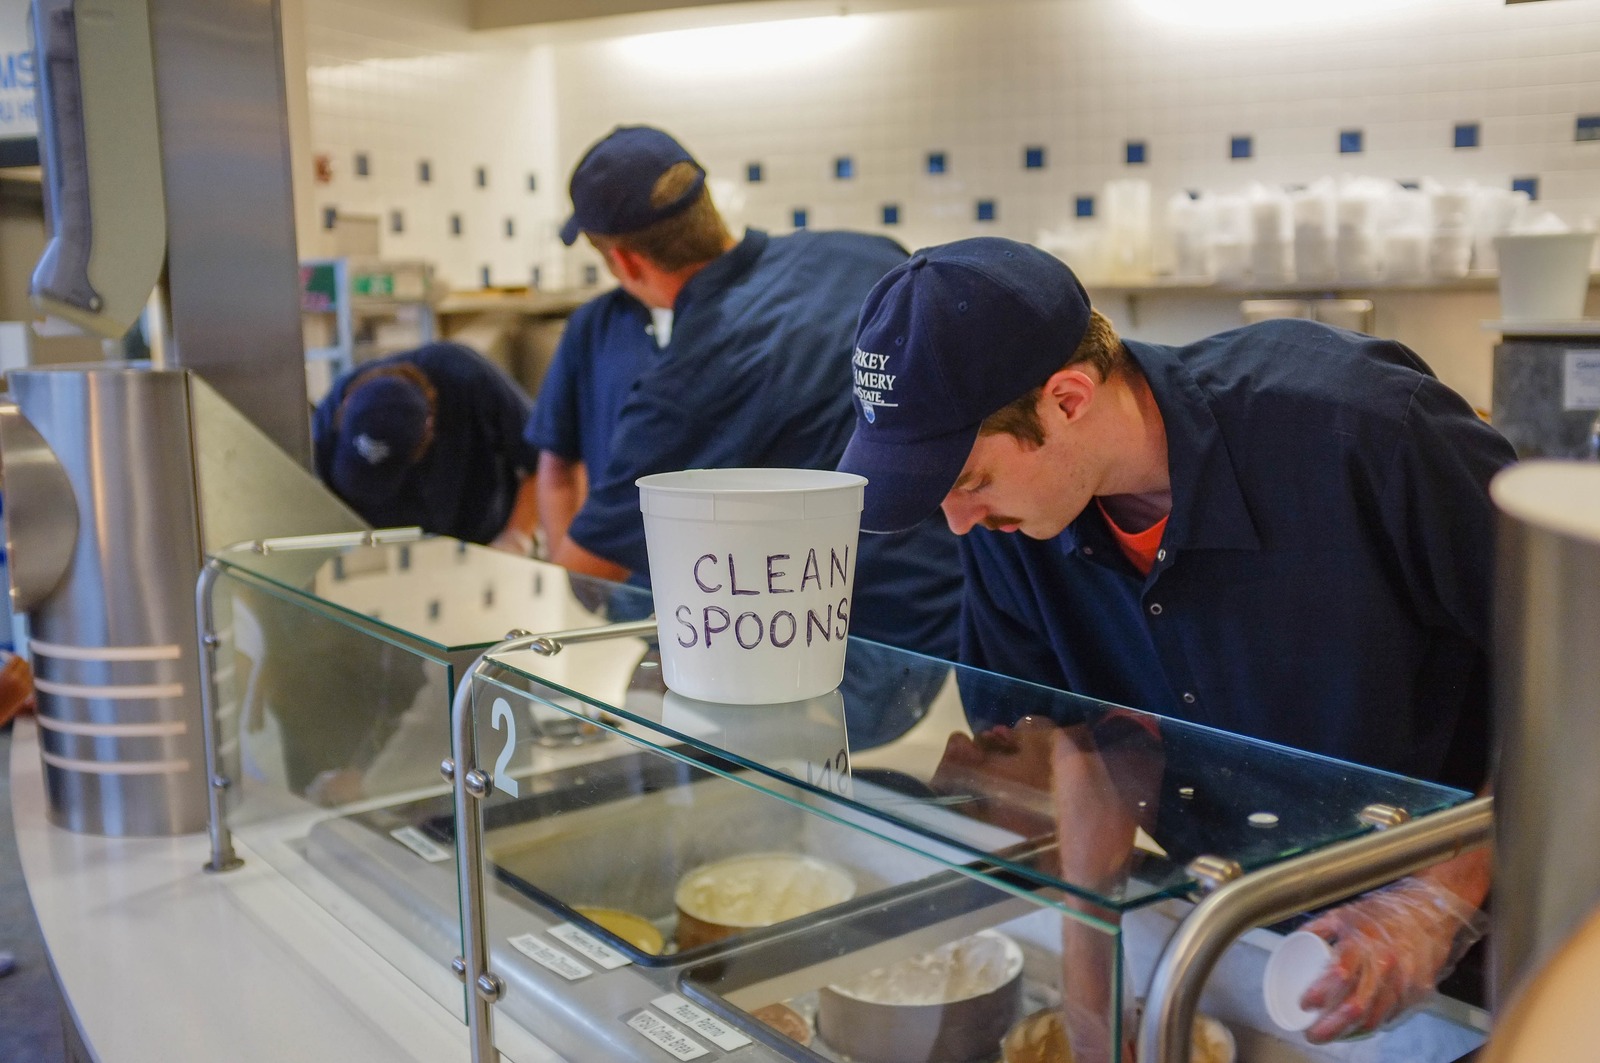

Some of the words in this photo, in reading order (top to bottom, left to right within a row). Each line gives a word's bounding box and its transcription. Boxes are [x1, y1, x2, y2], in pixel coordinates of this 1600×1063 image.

[854, 369, 896, 391] MERY
[693, 544, 849, 596] CLEAN
[675, 597, 849, 650] SPOONS
[491, 697, 519, 798] 2
